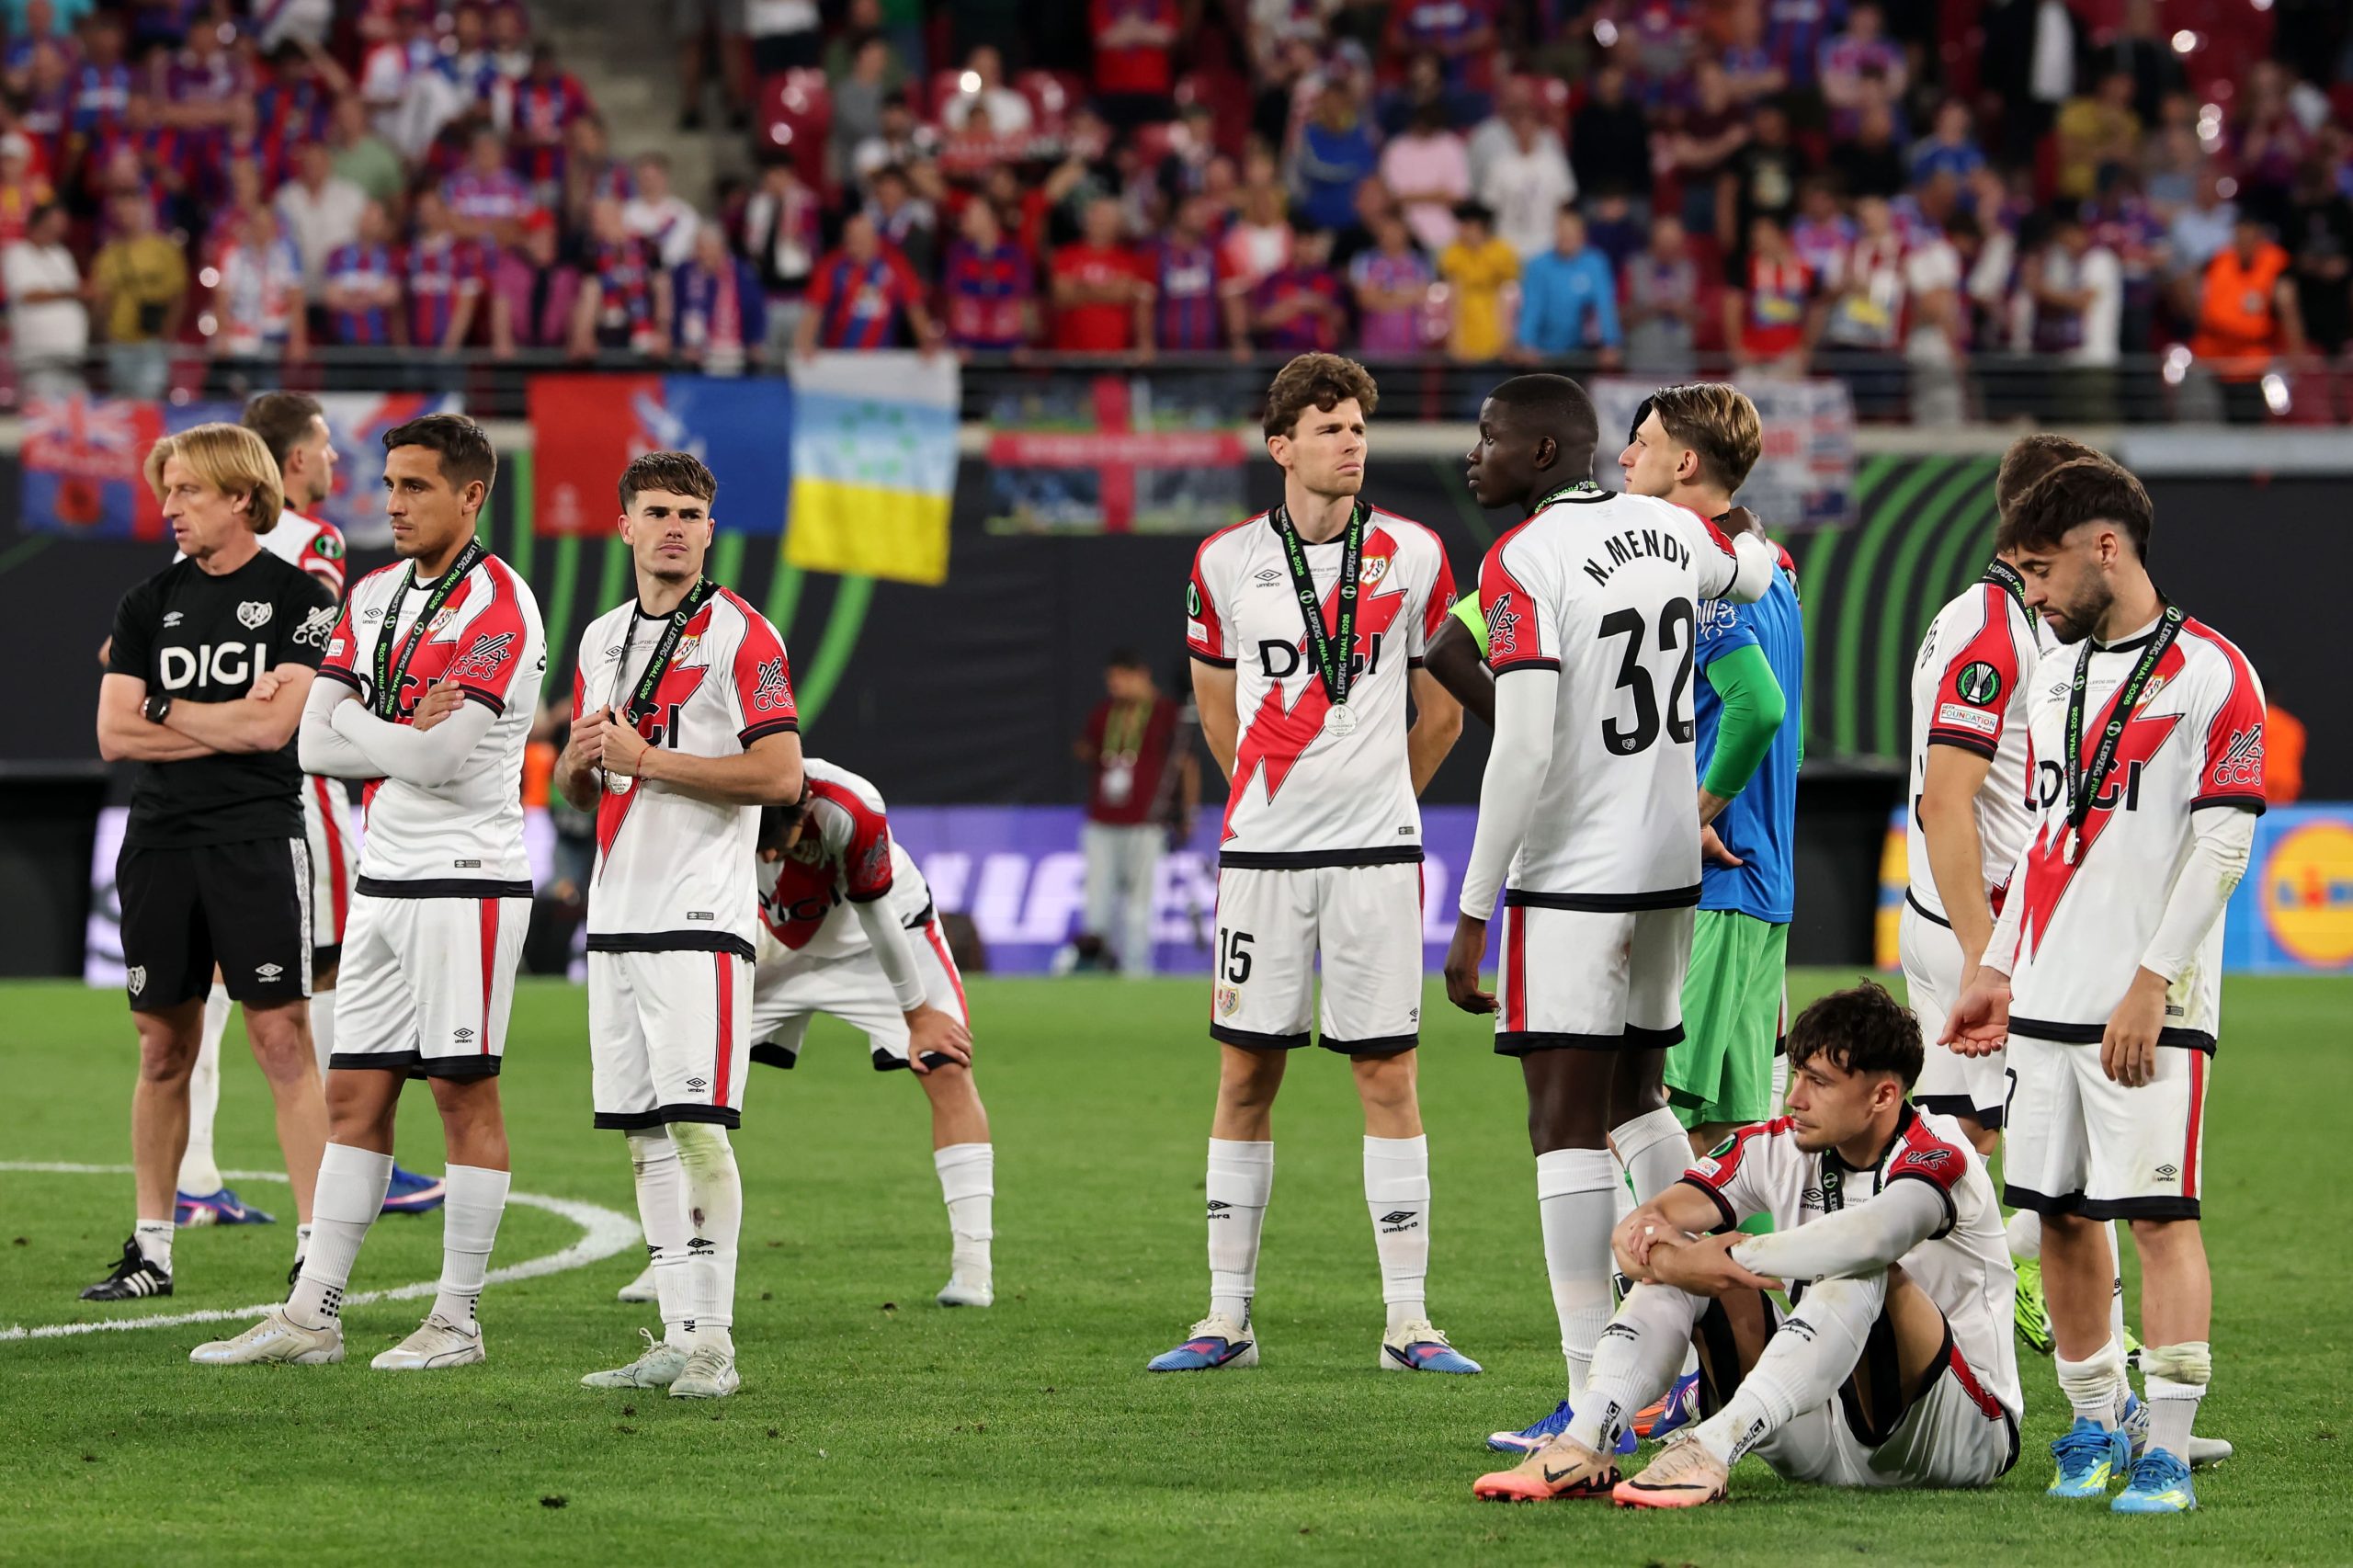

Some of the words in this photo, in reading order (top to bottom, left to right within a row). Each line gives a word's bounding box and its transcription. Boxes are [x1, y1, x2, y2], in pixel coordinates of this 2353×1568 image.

[1349, 526, 1359, 550] FINAL
[457, 544, 479, 571] LEIPZIG
[1286, 531, 1295, 556] FINAL
[1292, 555, 1305, 577] 2026
[1347, 551, 1357, 583] LEIPZIG
[1583, 528, 1690, 587] N.MENDY
[444, 568, 461, 593] FINAL
[428, 590, 446, 611] 2026
[1307, 606, 1324, 640] LEIPZIG
[1317, 638, 1326, 665] FINAL
[1342, 613, 1350, 635] 2026
[378, 642, 388, 662] 2026
[663, 626, 679, 659] LEIPZIG
[1339, 636, 1348, 662] FINAL
[2149, 621, 2175, 657] LEIPZIG
[160, 642, 267, 690] DIGI
[398, 637, 416, 672] LEIPZIG
[378, 661, 387, 690] FINAL
[650, 655, 665, 683] FINAL
[1337, 662, 1347, 695] LEIPZIG
[1597, 597, 1695, 756] 32
[2135, 655, 2155, 683] FINAL
[391, 669, 404, 699] FINAL
[640, 680, 654, 700] 2026
[2123, 680, 2140, 707] 2026
[385, 696, 396, 715] 2026
[754, 689, 795, 712] GCS
[1941, 709, 1996, 728] FOUNDATION
[2070, 706, 2079, 730] 2026
[2069, 731, 2077, 759] FINAL
[2092, 739, 2113, 777] LEIPZIG
[2213, 764, 2261, 787] GCS
[1220, 926, 1256, 984] 15
[1382, 1221, 1419, 1234] umbro
[688, 1248, 715, 1256] umbro
